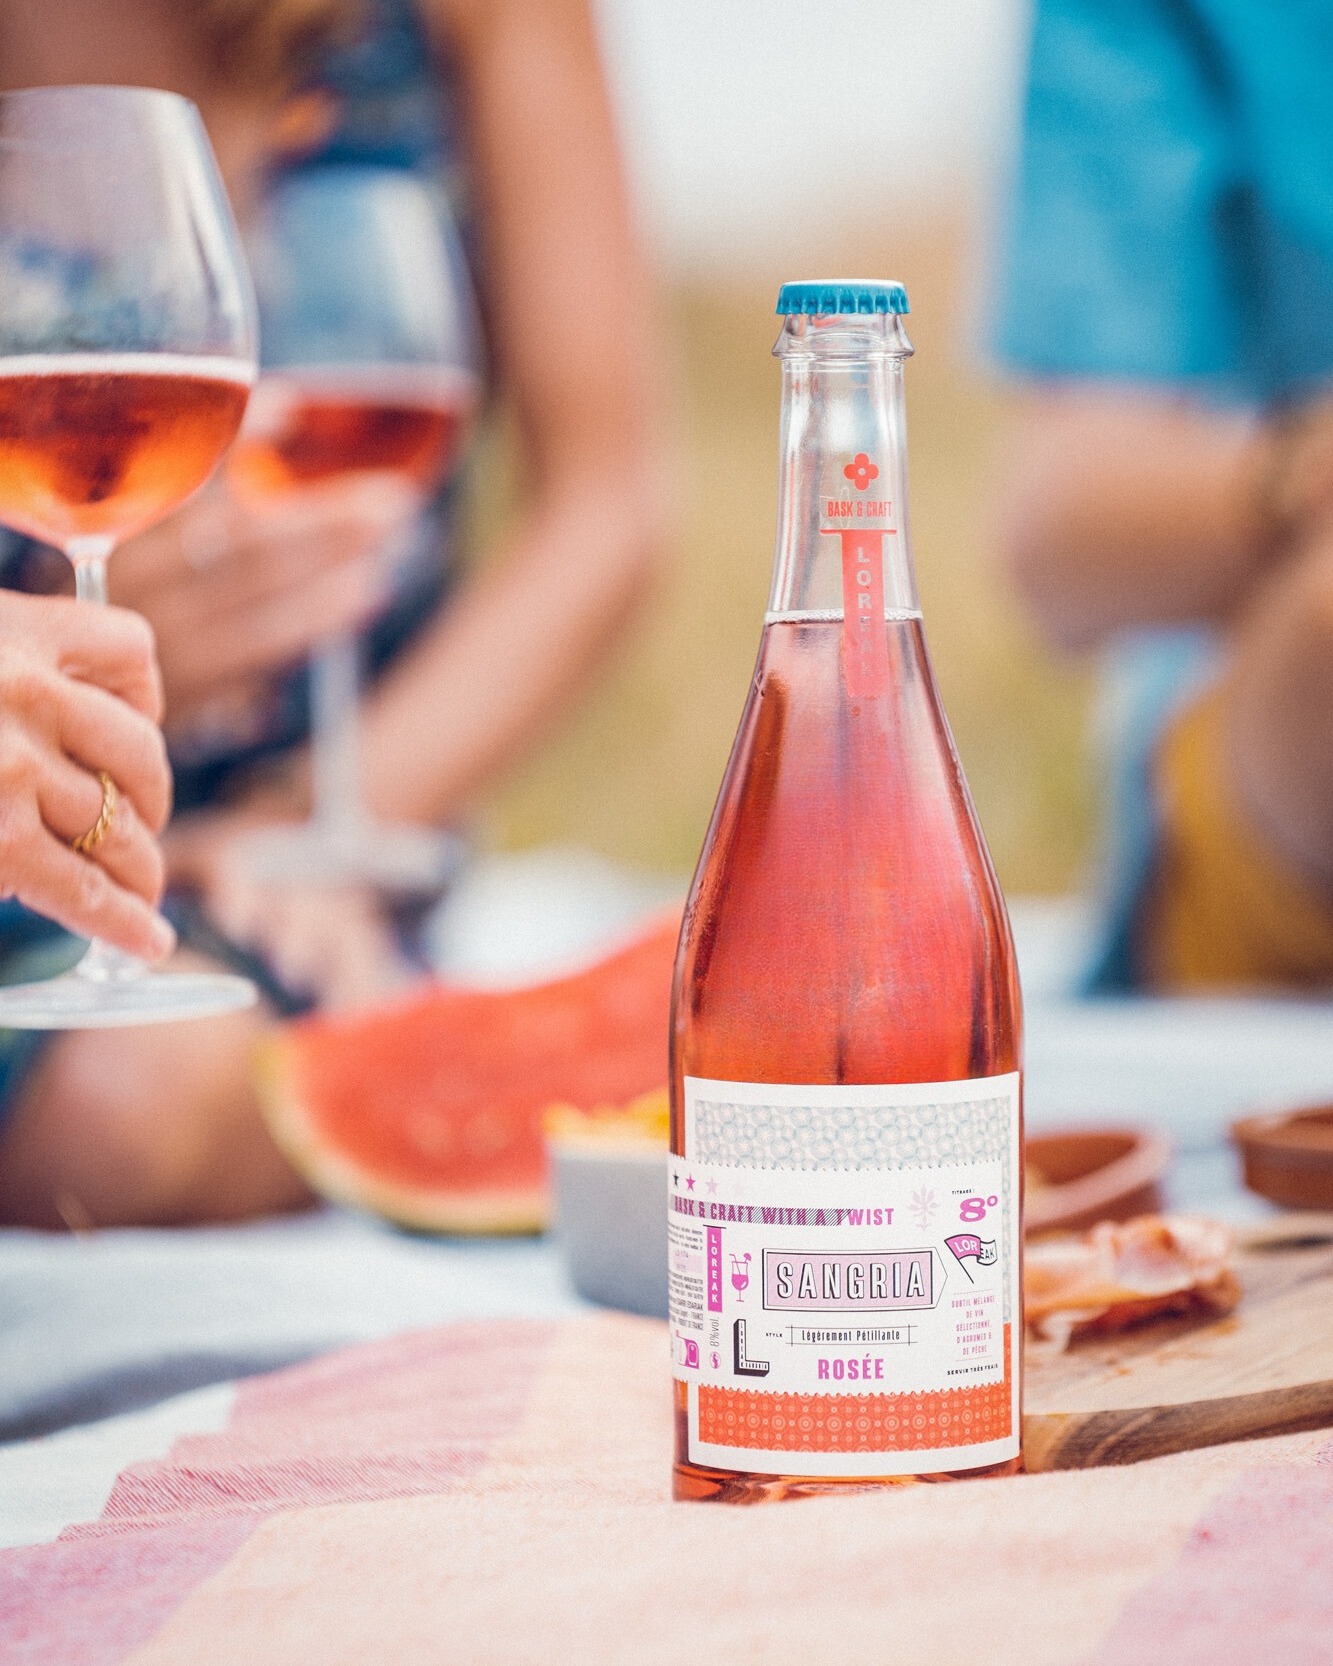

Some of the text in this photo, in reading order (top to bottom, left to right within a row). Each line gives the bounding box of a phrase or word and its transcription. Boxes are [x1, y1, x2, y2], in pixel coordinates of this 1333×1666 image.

[827, 501, 893, 519] BASK & CRAFT
[698, 1200, 706, 1219] &
[710, 1202, 754, 1223] CRAFT
[761, 1206, 808, 1226] WITH
[815, 1208, 827, 1226] A
[834, 1208, 895, 1226] TWIST
[953, 1239, 978, 1254] LOR
[711, 1234, 719, 1303] LOREAK
[777, 1260, 925, 1300] SANGRIA
[856, 1330, 900, 1342] Pétillante
[818, 1353, 884, 1380] ROSÉE
[947, 1367, 968, 1376] SERVIR
[970, 1364, 984, 1372] TRÈS
